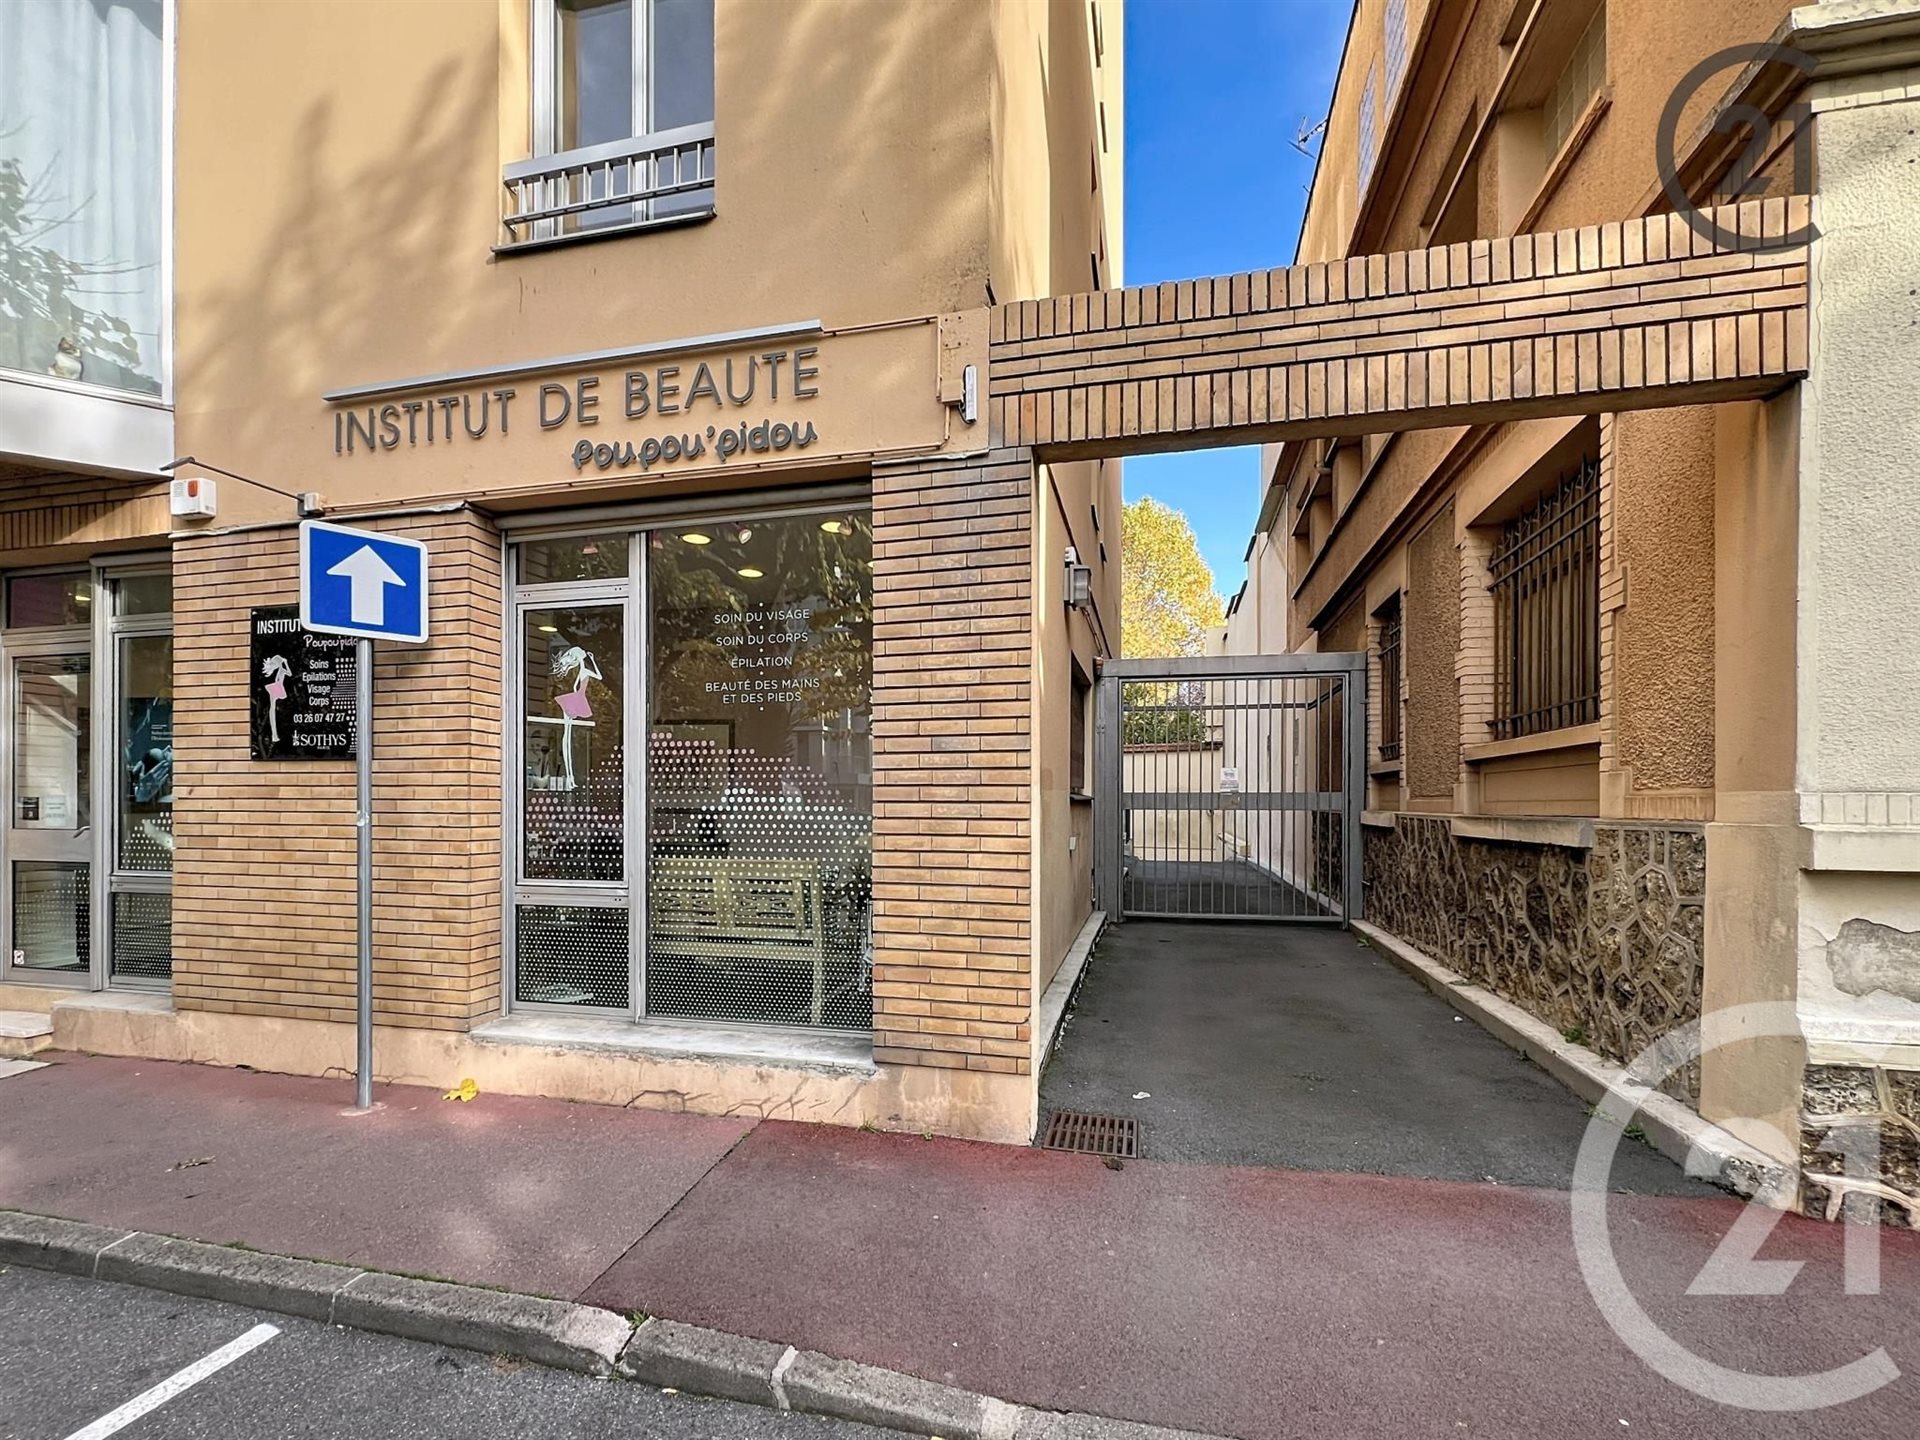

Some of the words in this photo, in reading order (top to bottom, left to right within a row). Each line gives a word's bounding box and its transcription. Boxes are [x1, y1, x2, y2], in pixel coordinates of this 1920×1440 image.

[335, 389, 516, 453] INSTITUT
[540, 376, 600, 429] DE
[624, 347, 819, 417] BEAUTE
[714, 613, 742, 625] SOIN
[746, 612, 763, 622] DU
[766, 609, 810, 620] VISAGE
[257, 618, 301, 635] INSTITUT
[716, 636, 744, 647] SOIN
[747, 635, 764, 645] DU
[768, 632, 809, 643] CORPS
[309, 659, 329, 670] Soins
[731, 656, 793, 669] ÉPILATION
[302, 671, 337, 684] Epilations
[307, 684, 331, 696] Visage
[705, 679, 752, 692] BEAUTÉ
[755, 680, 778, 690] DES
[782, 678, 820, 689] MAINS
[308, 696, 330, 708] Corps
[723, 694, 737, 704] ET
[741, 693, 764, 703] DES
[767, 691, 802, 702] PIEDS
[293, 713, 303, 724] 03
[304, 713, 314, 723] 26
[314, 713, 324, 723] 07
[325, 713, 335, 723] 47
[335, 712, 346, 723] 27
[300, 733, 347, 747] SOTHYS
